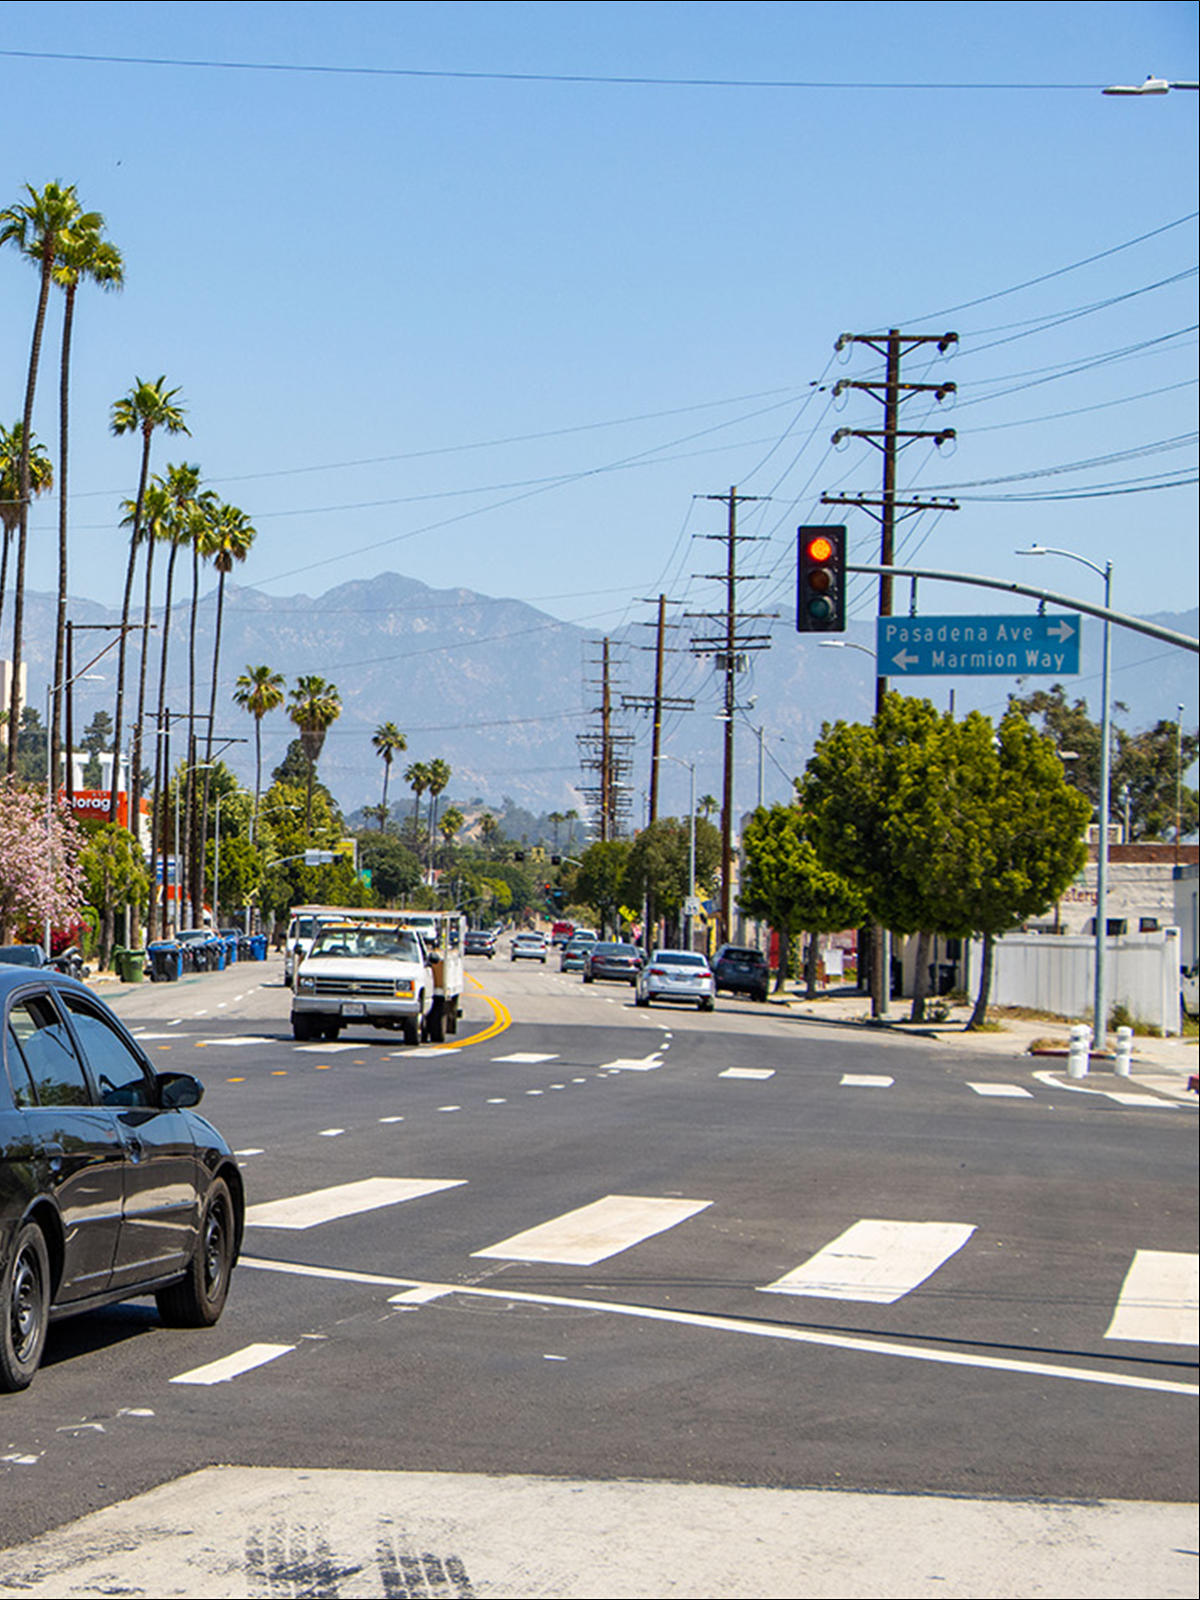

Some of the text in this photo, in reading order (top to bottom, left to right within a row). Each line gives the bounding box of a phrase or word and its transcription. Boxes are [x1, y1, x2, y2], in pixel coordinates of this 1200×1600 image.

[885, 623, 1033, 642] Pasadena Ave
[932, 649, 1065, 672] Marmion Way
